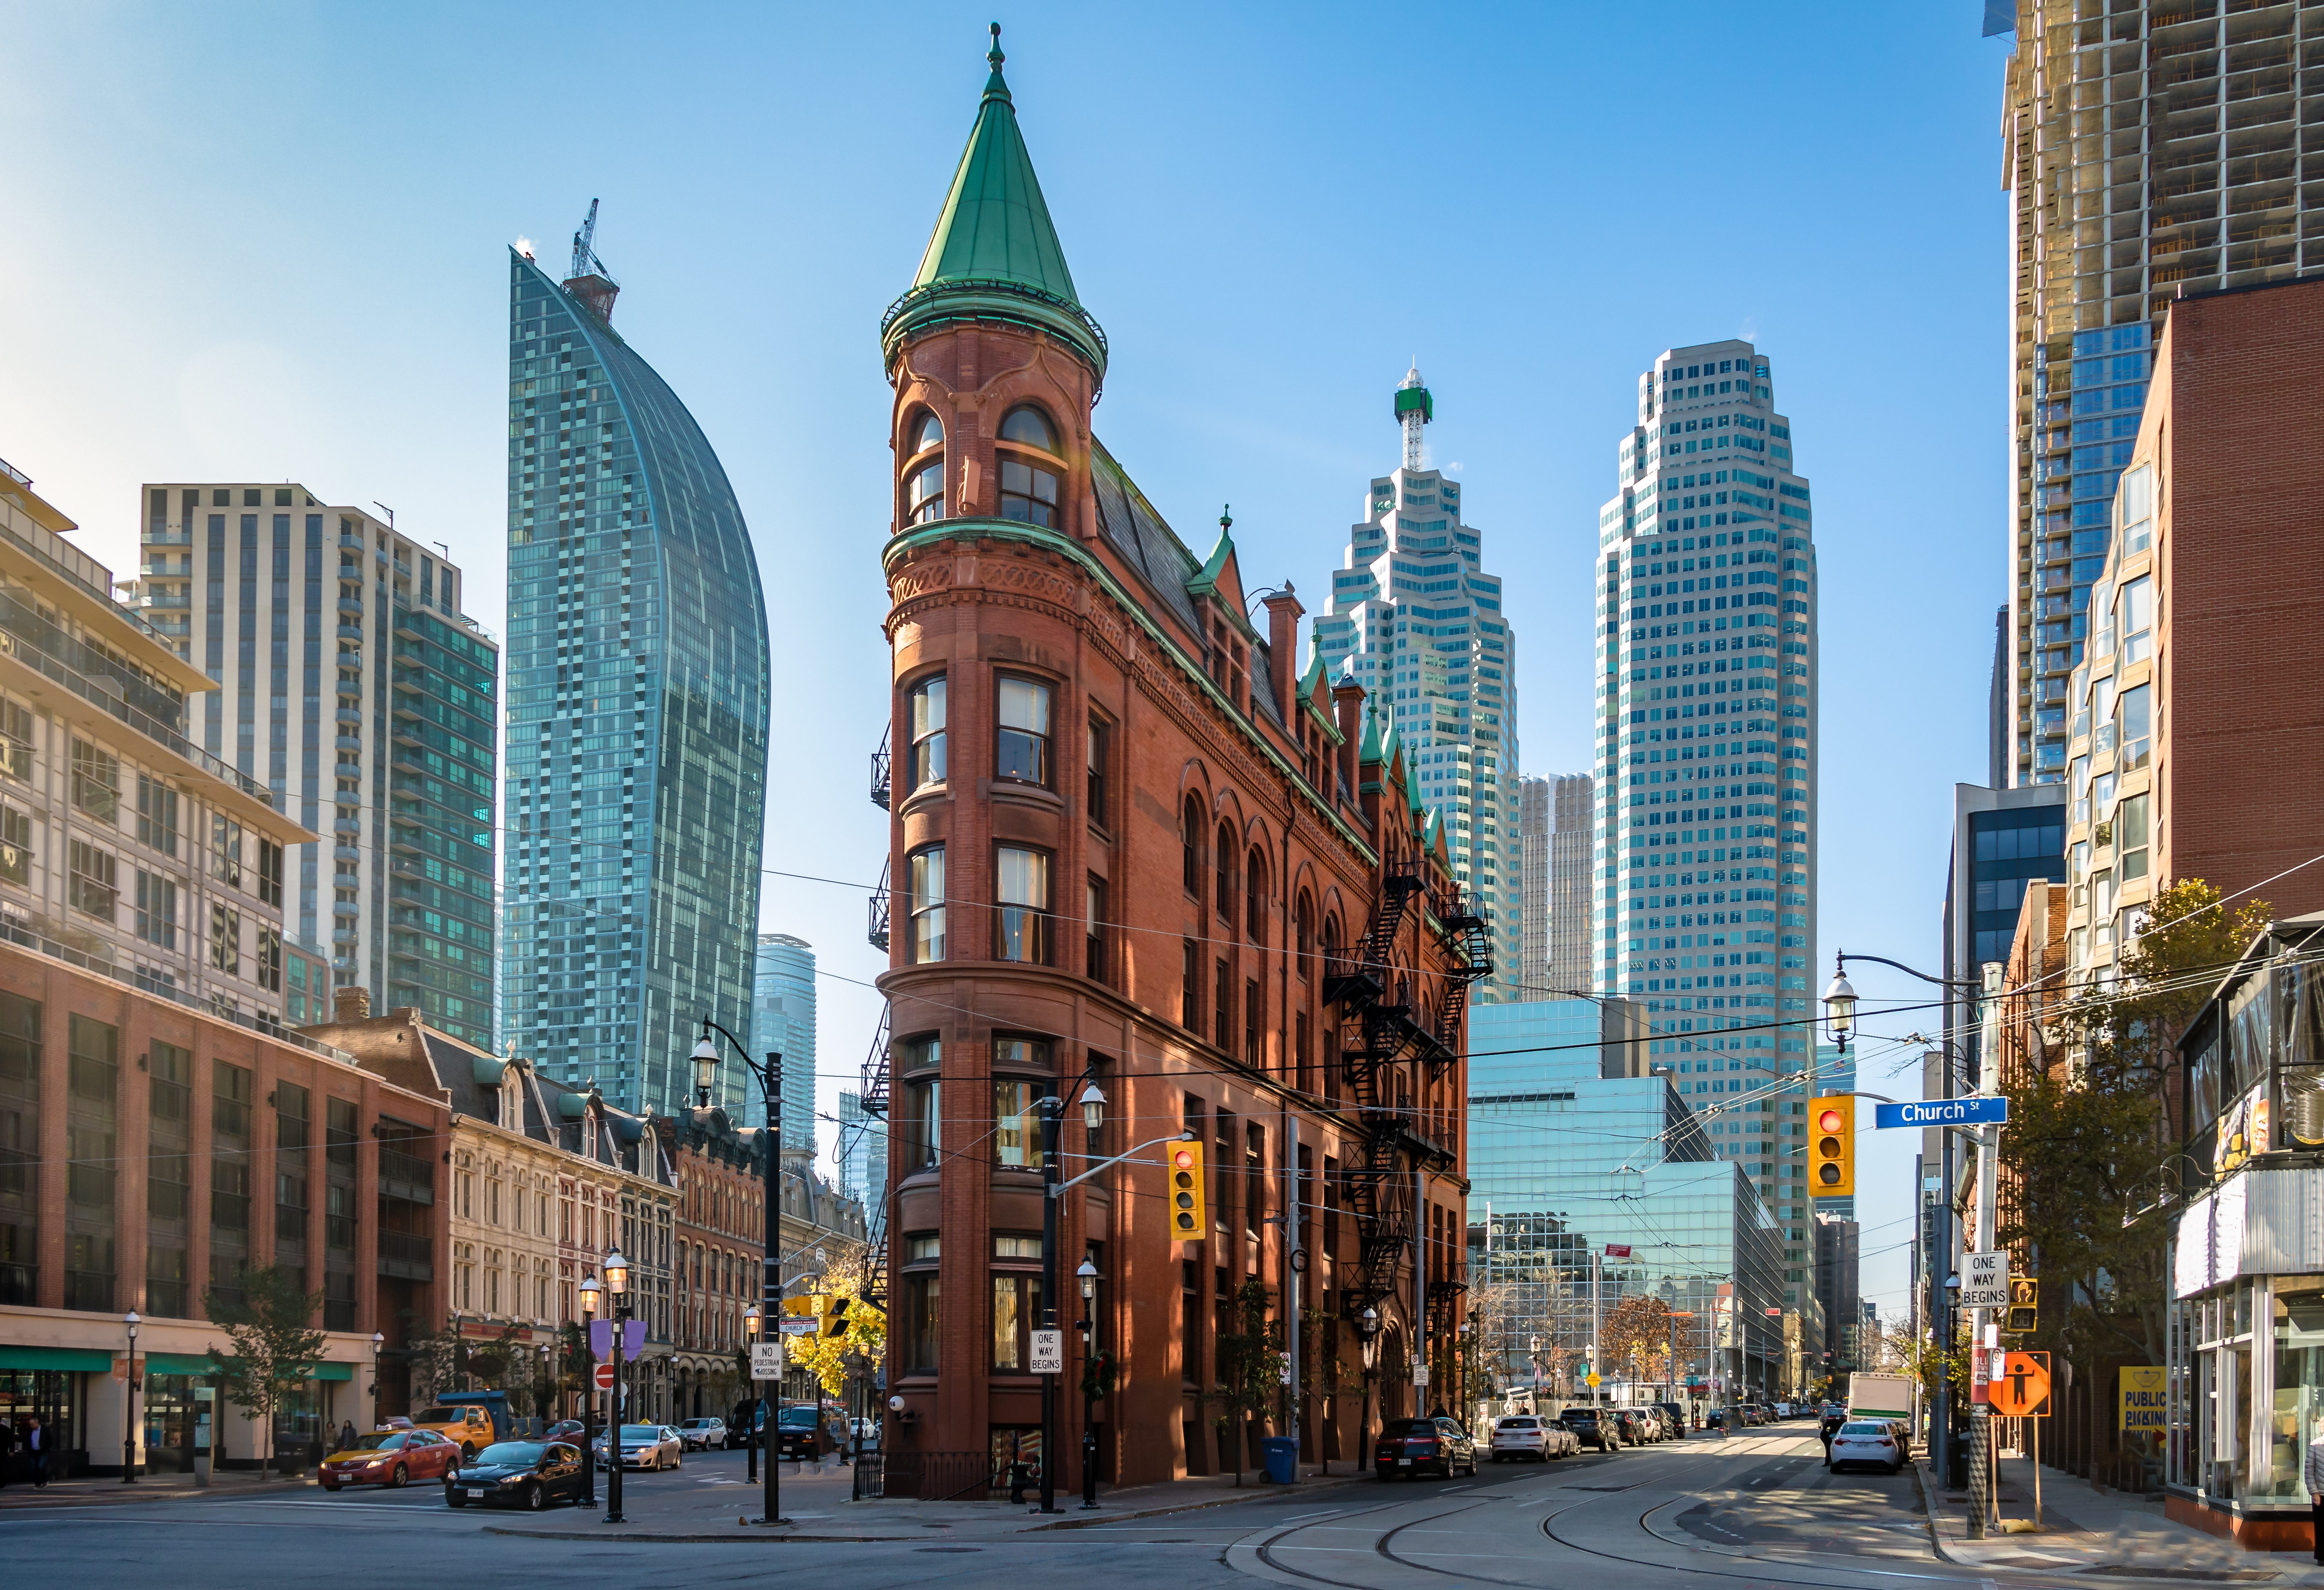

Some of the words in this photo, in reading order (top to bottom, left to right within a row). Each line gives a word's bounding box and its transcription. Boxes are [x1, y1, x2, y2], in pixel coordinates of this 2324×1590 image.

[1901, 1102, 1964, 1122] Church
[1970, 1101, 1980, 1111] St
[1973, 1256, 1996, 1269] ONE
[1973, 1273, 1995, 1286] WAY
[1964, 1290, 2005, 1303] BEGINS
[1038, 1334, 1054, 1343] ONE
[762, 1347, 773, 1357] NO
[1038, 1347, 1053, 1356] WAY
[1032, 1359, 1060, 1369] BEGINS
[2125, 1391, 2166, 1407] PUBLIC
